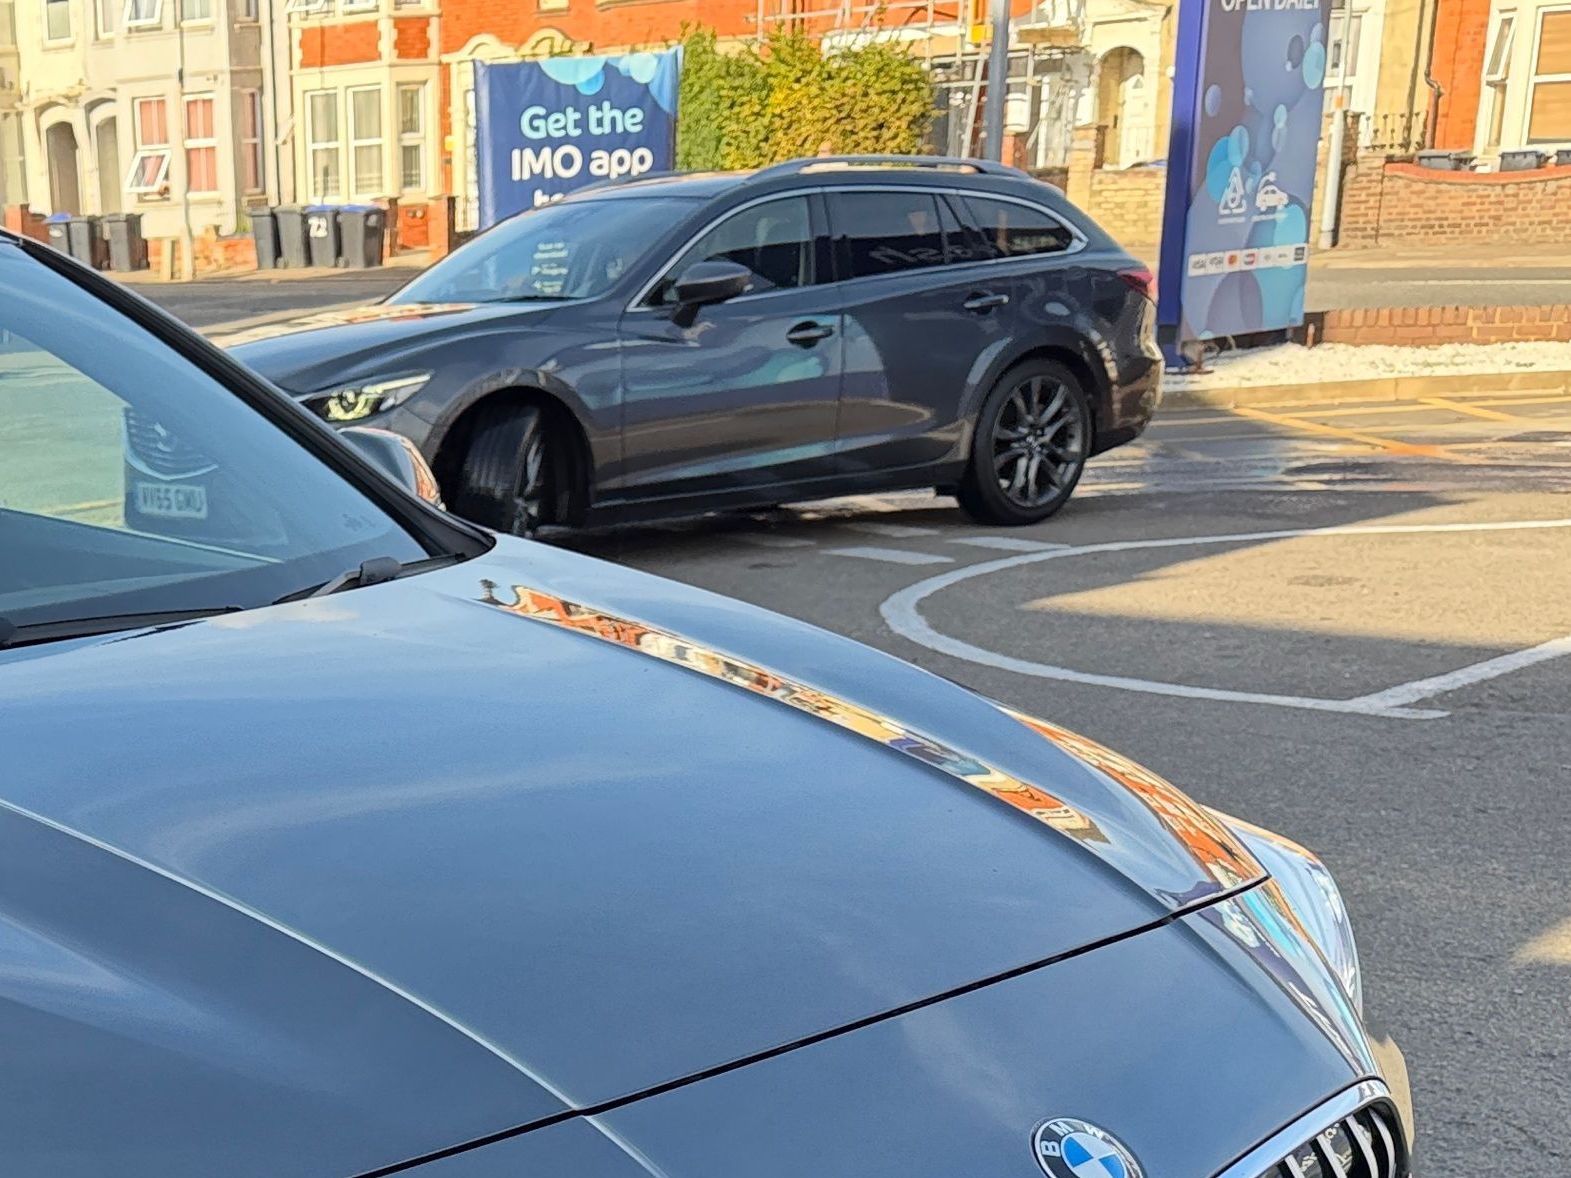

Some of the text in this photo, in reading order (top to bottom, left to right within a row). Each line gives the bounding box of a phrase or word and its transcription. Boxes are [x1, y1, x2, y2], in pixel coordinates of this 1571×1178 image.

[520, 101, 644, 139] Get the
[511, 144, 654, 181] IMO app
[1040, 1120, 1105, 1158] BMW
